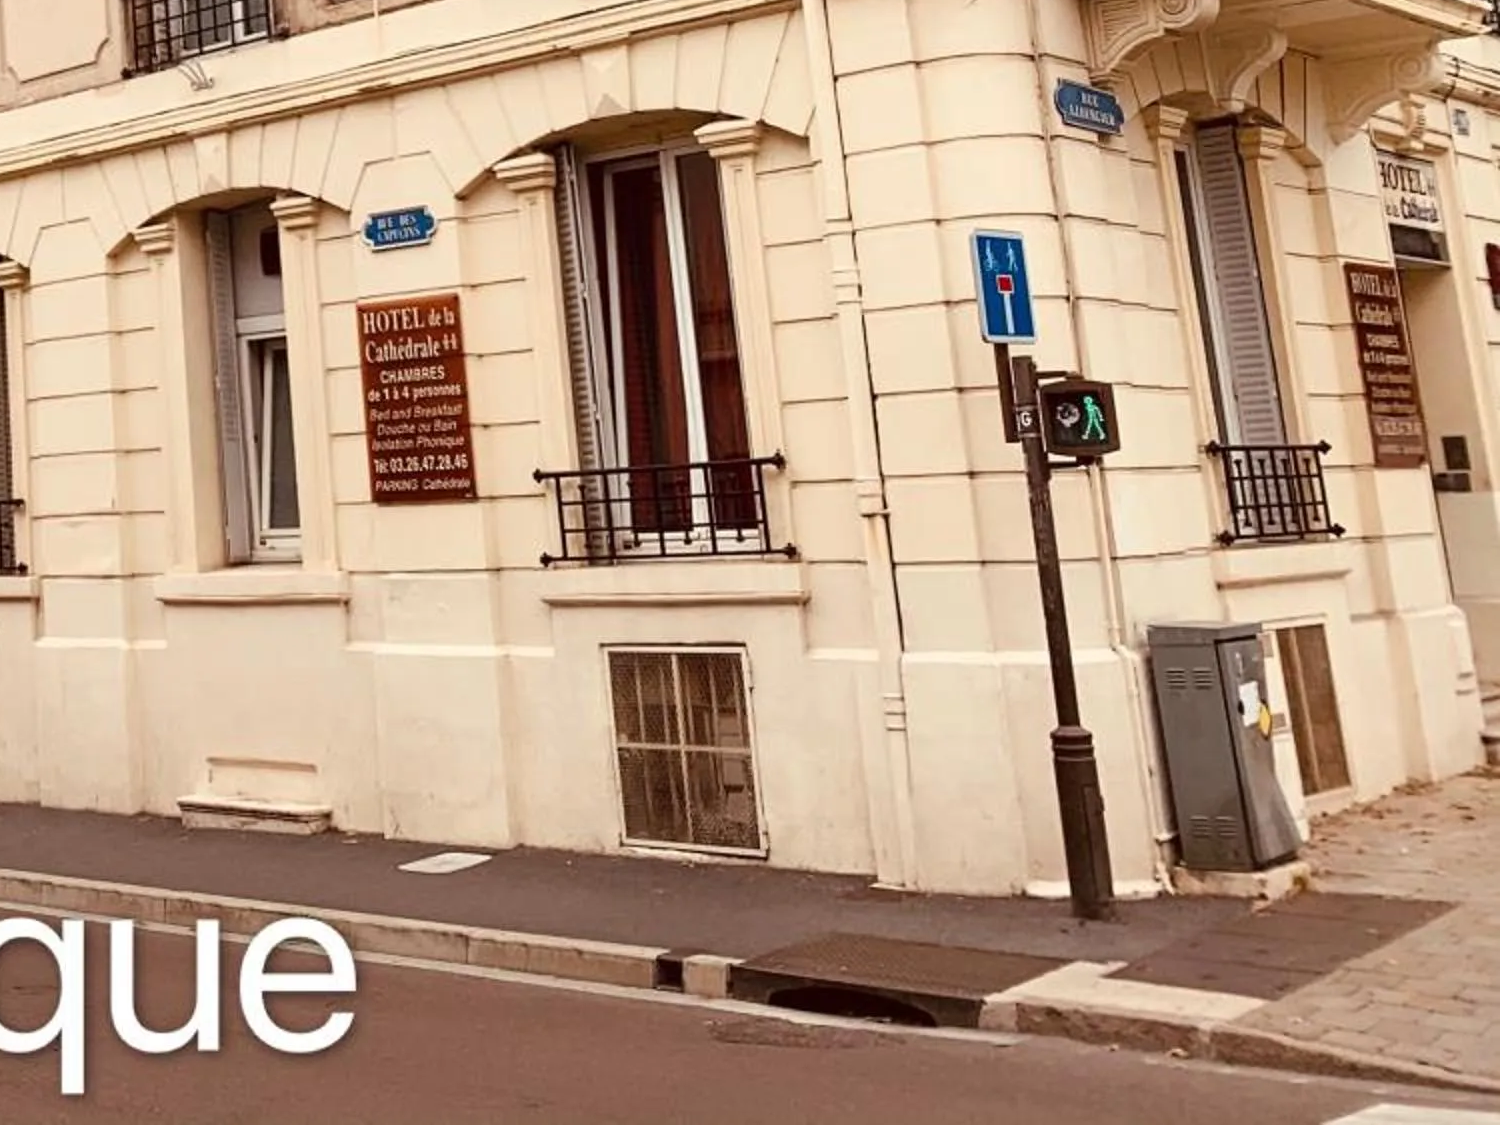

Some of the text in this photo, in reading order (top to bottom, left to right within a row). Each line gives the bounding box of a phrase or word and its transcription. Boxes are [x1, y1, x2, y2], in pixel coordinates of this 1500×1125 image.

[361, 306, 455, 334] HOTEL de la
[365, 334, 440, 363] Cathédrale
[380, 364, 445, 383] CHAMBRES
[367, 388, 380, 402] de
[383, 387, 390, 400] 1
[401, 385, 409, 399] 4
[412, 384, 461, 402] personnes
[375, 479, 419, 492] PARKING
